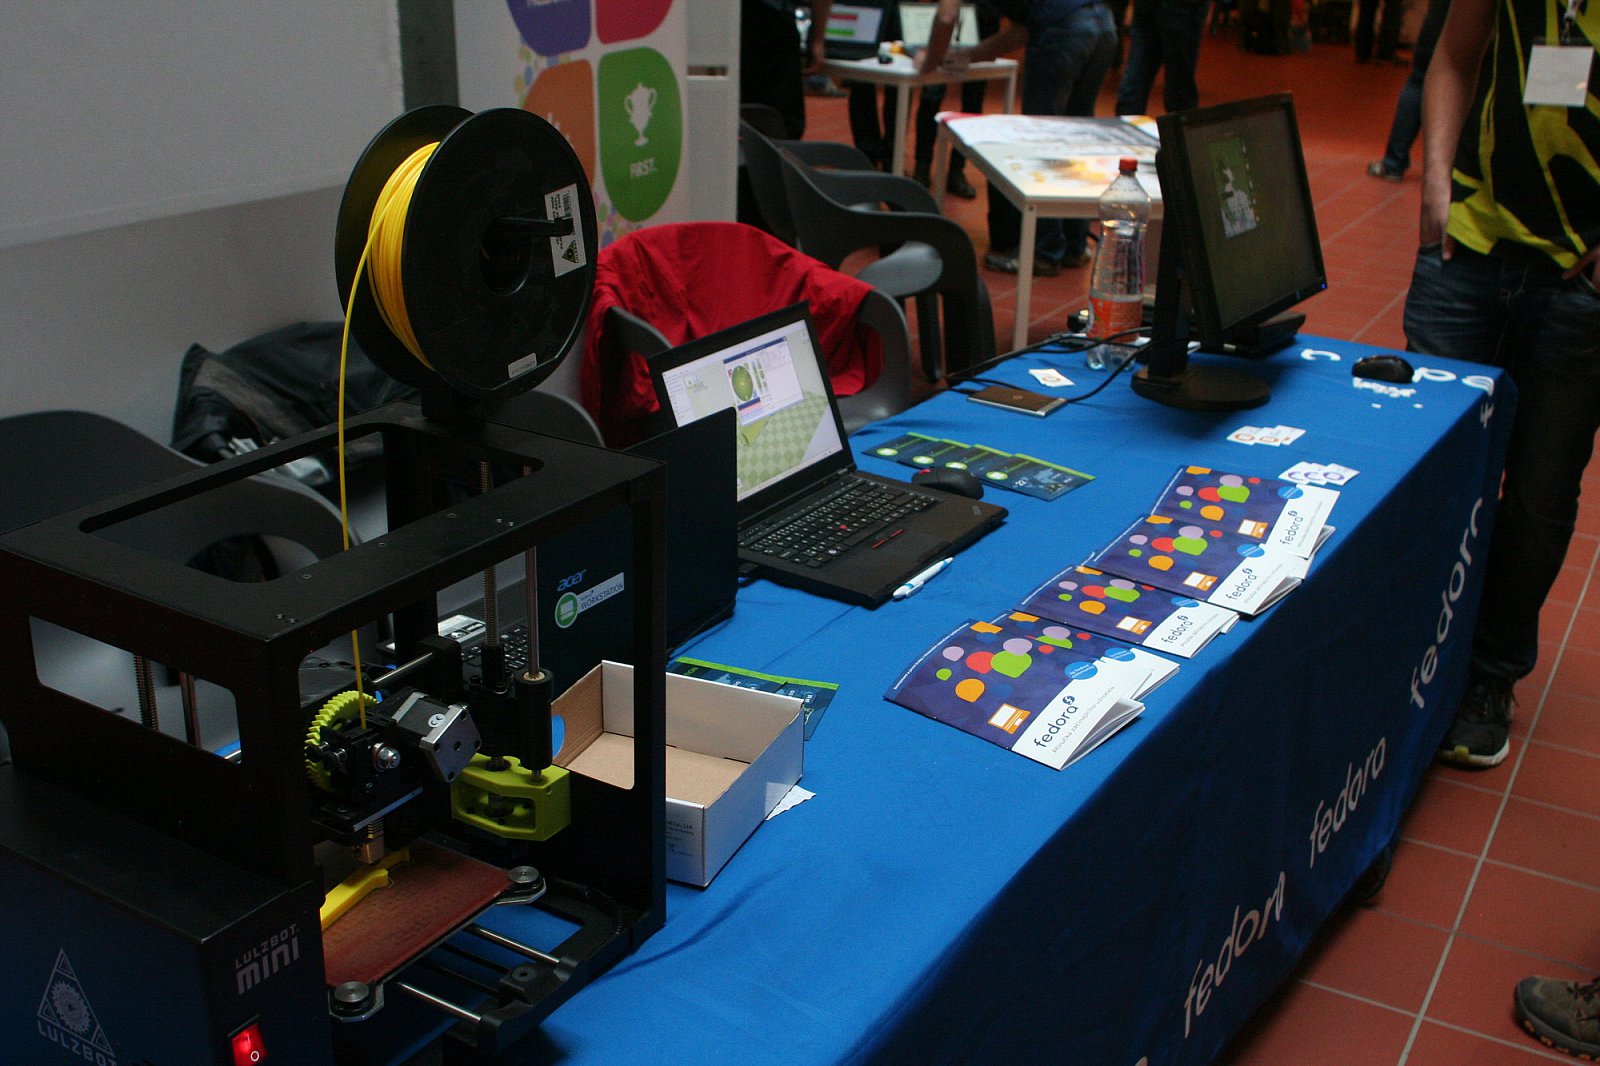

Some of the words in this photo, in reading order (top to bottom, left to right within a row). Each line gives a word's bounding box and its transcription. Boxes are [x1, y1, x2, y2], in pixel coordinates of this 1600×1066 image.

[1280, 517, 1303, 545] fedora
[557, 569, 587, 592] acer
[1225, 574, 1257, 600] fedora
[580, 583, 624, 610] WORKSTATION
[1161, 620, 1193, 644] fedora
[1034, 705, 1079, 748] fedora
[235, 923, 299, 970] LULZBOT
[236, 936, 300, 995] mini
